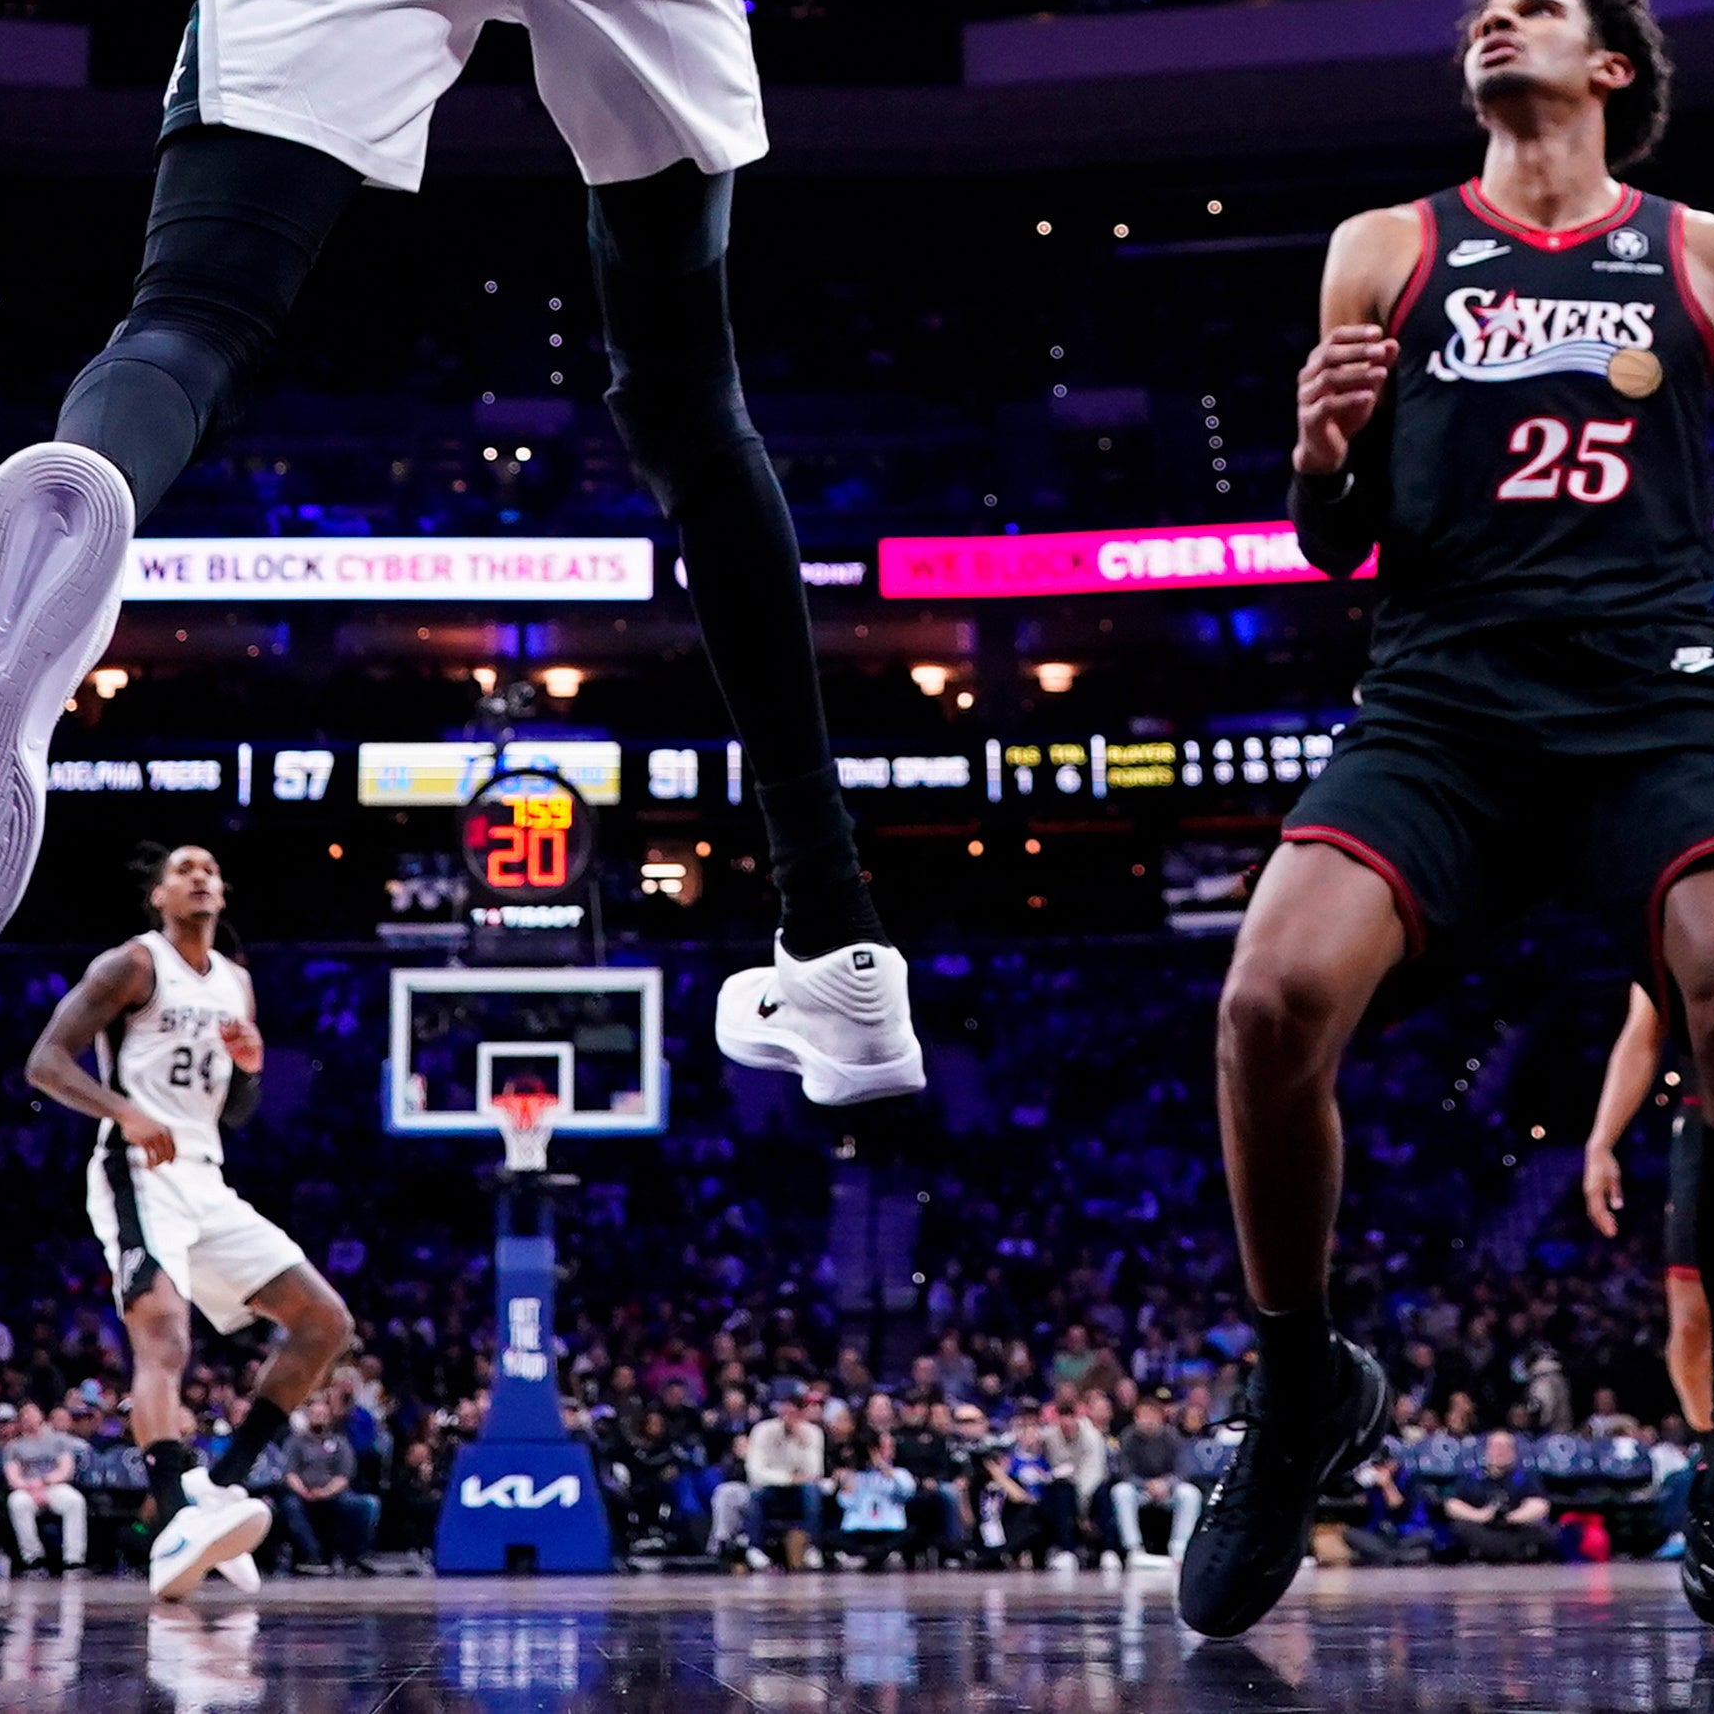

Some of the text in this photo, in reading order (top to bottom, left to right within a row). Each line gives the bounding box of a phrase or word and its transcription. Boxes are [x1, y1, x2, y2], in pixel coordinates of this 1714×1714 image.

[1426, 286, 1655, 383] SIXERS
[1495, 415, 1637, 504] 25
[140, 552, 628, 584] WE BLOCK CYBER THREATS
[1097, 535, 1228, 581] CYBER
[273, 750, 335, 800] 57
[486, 826, 568, 887] 20
